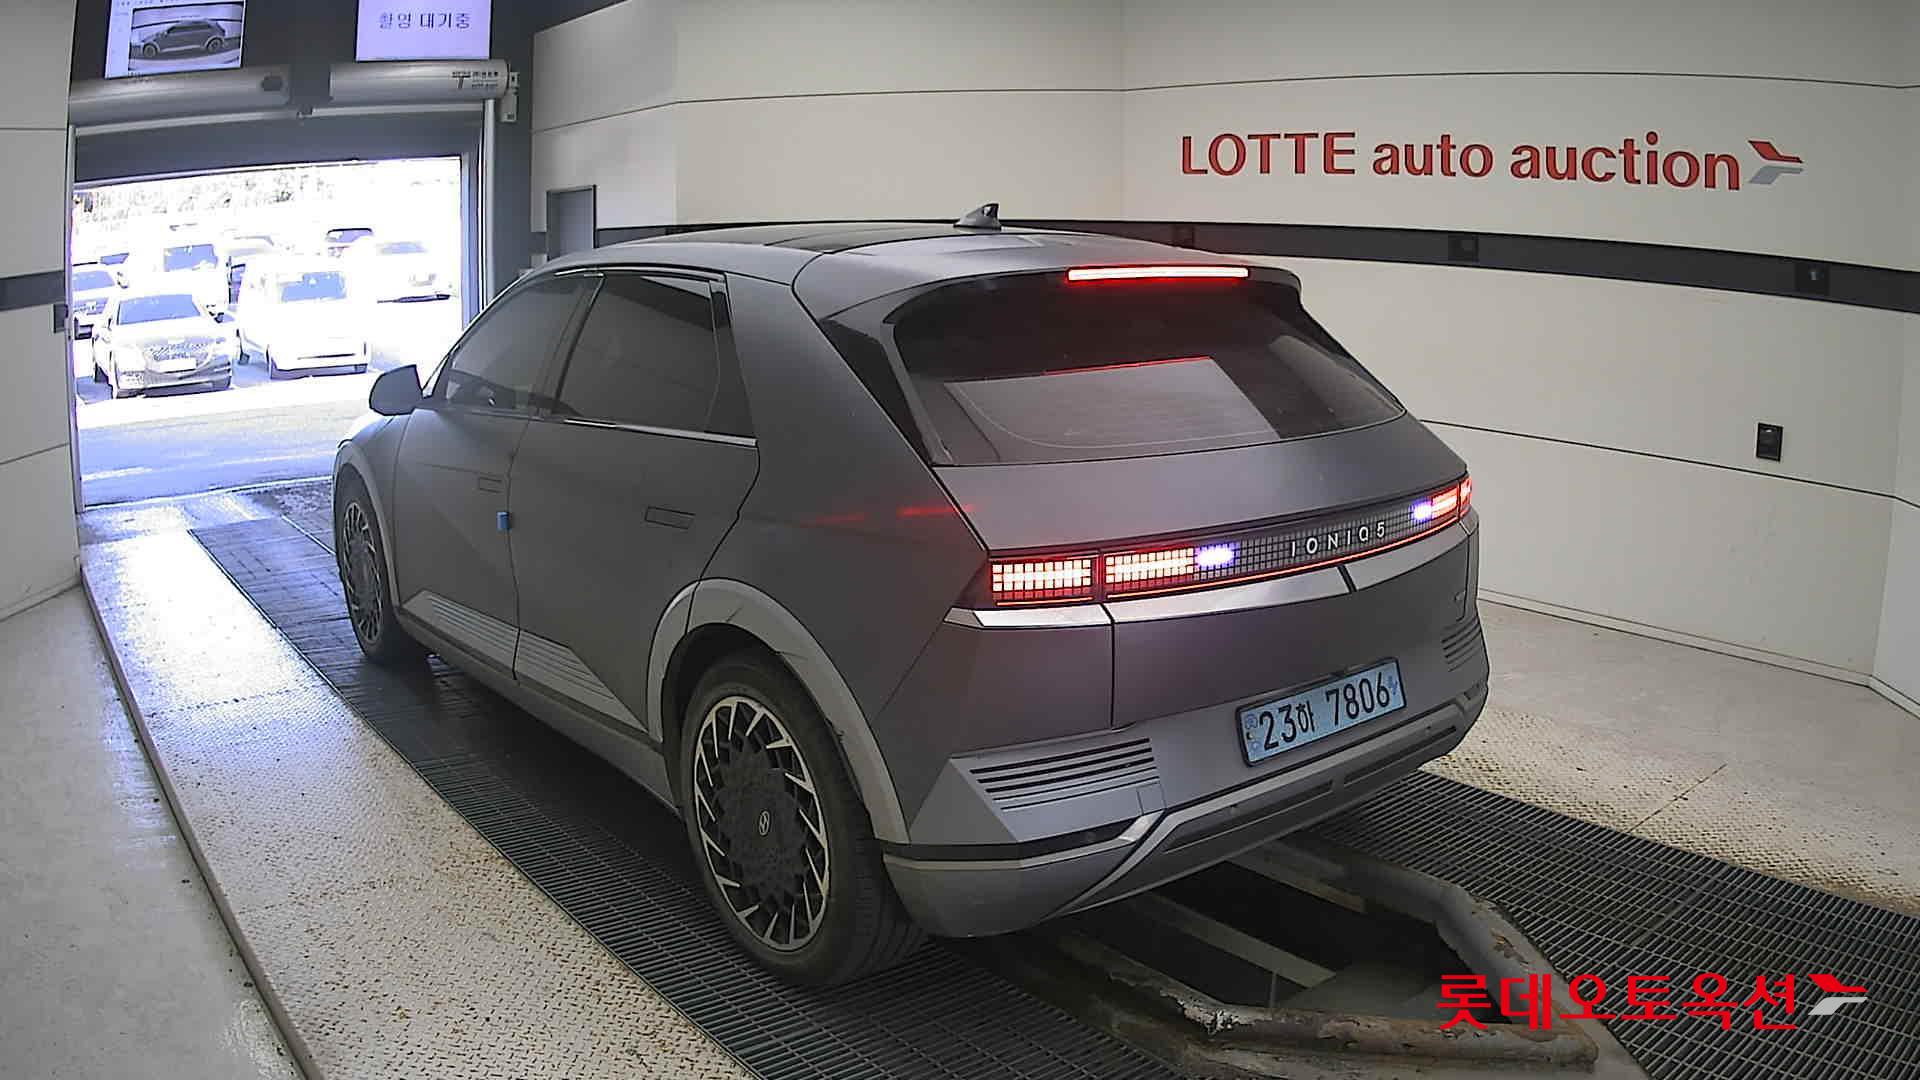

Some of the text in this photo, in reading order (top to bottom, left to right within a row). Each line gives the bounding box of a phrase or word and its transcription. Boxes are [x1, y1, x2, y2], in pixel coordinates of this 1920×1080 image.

[419, 12, 471, 29] 대기중
[1182, 131, 1740, 191] LOTTE auto auction
[1259, 672, 1390, 750] 23하 7806
